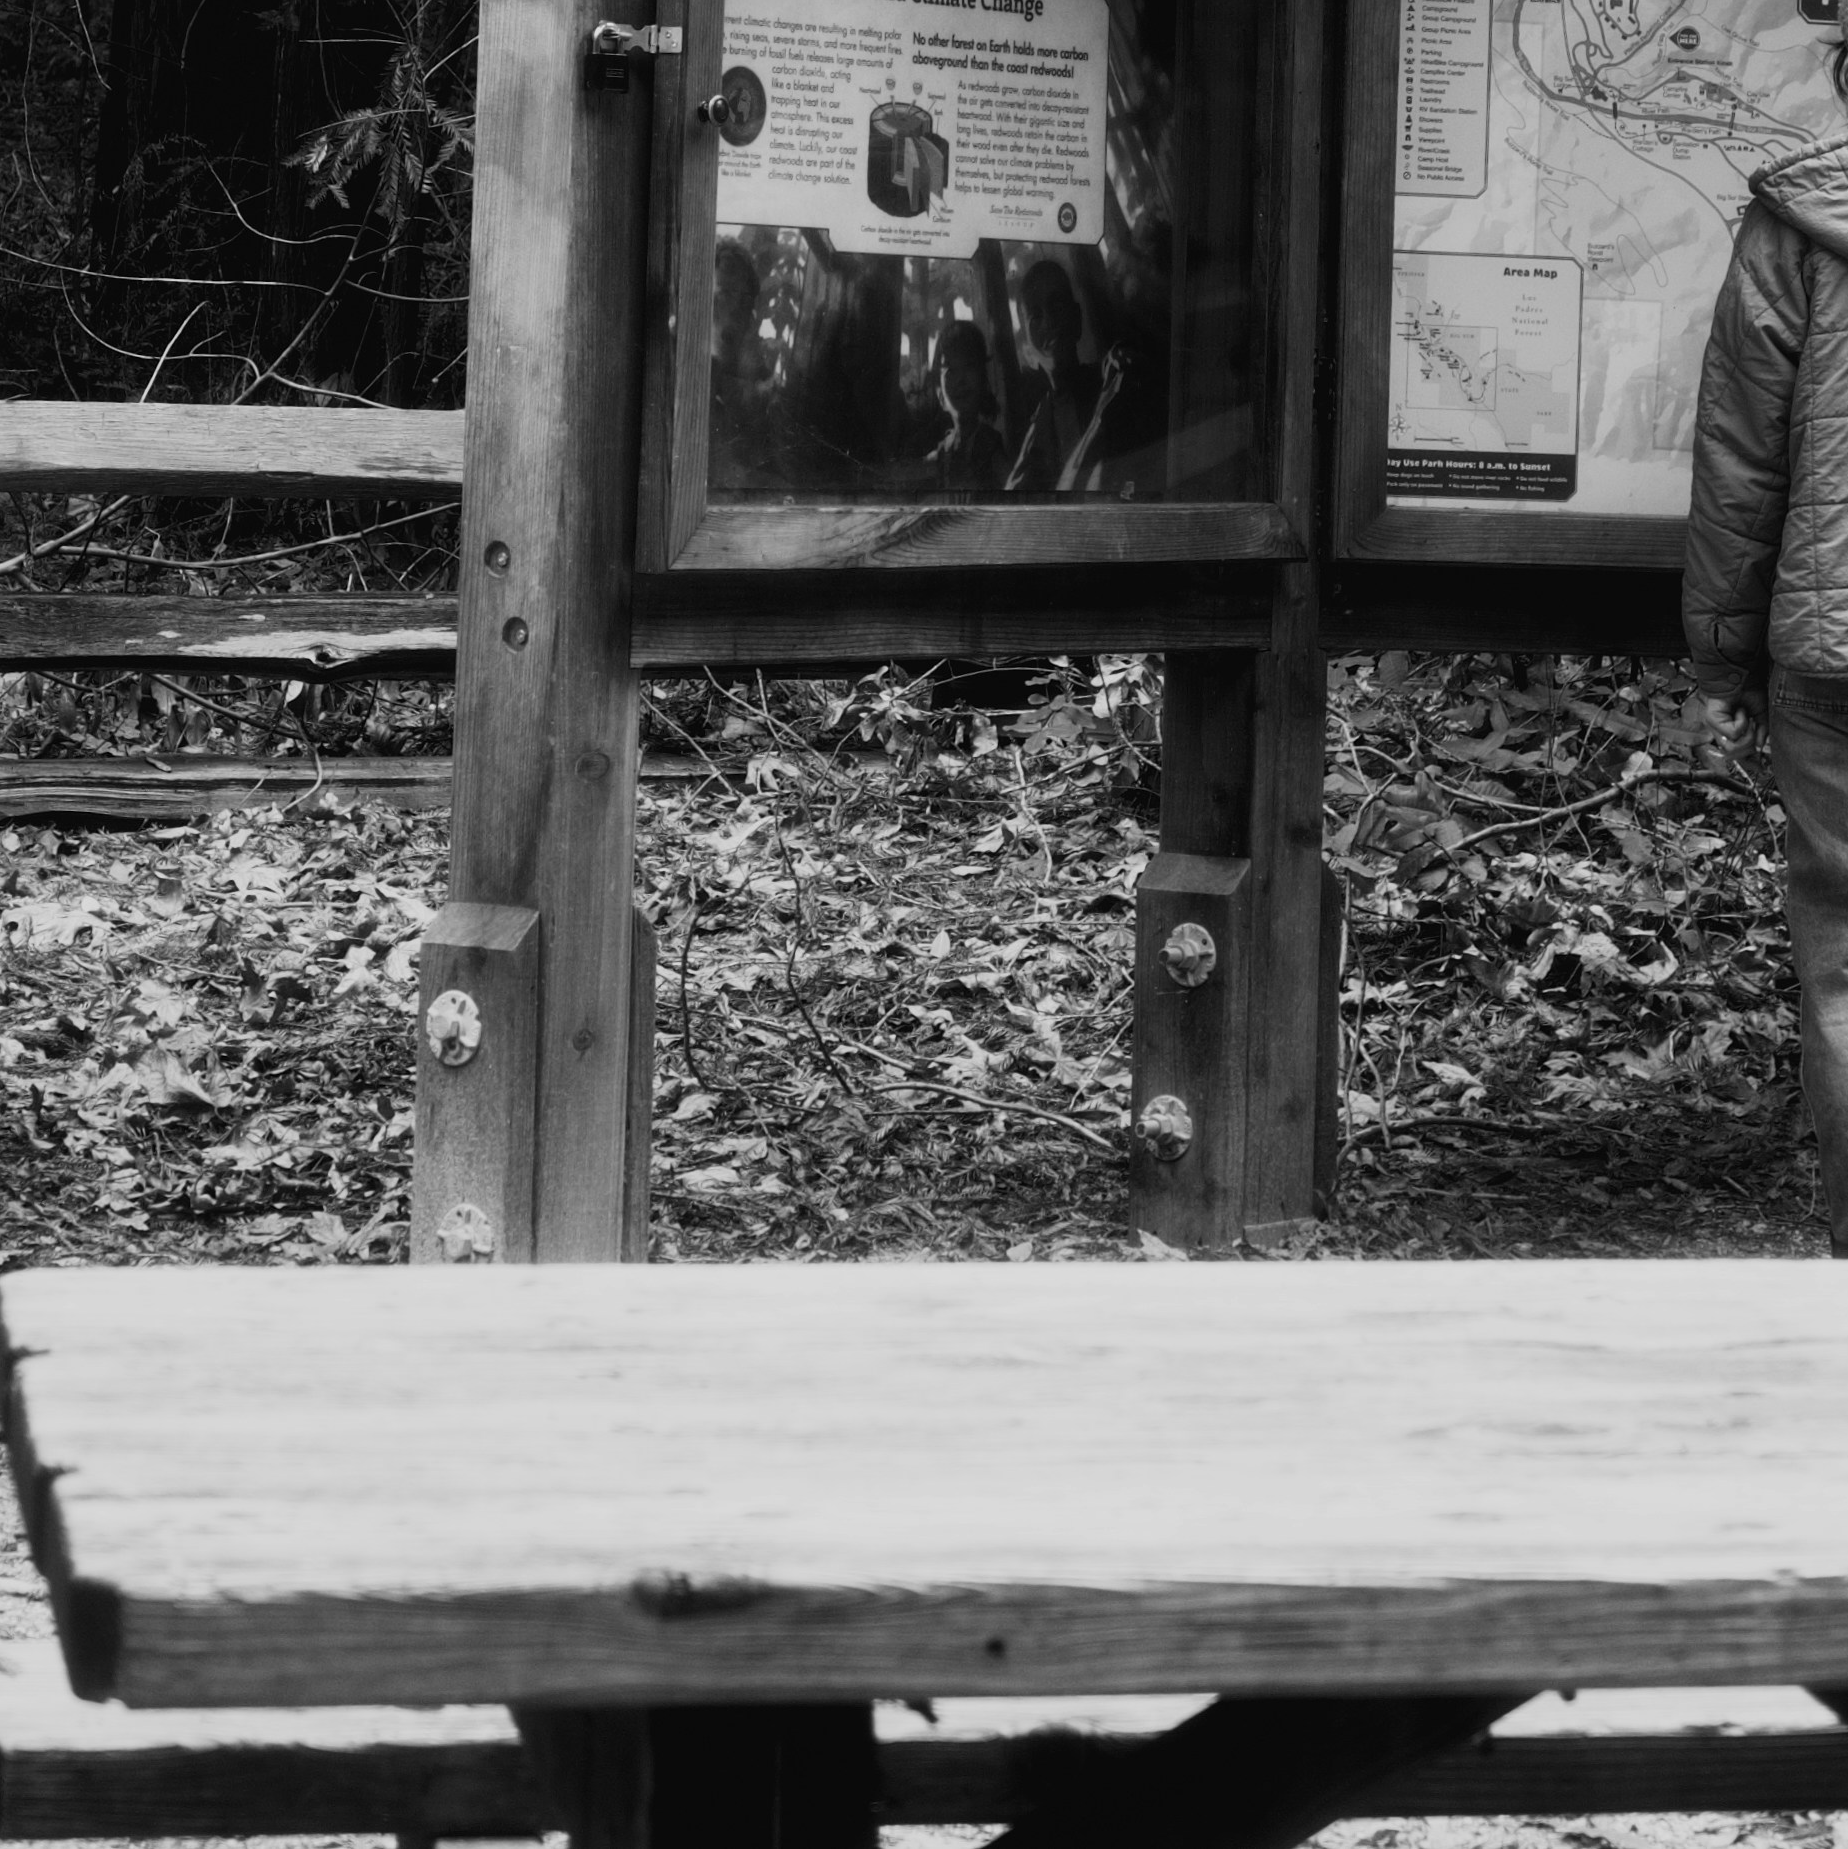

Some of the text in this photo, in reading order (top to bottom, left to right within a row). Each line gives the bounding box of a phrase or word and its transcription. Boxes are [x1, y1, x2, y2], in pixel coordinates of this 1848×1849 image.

[913, 32, 1089, 61] No other forest on Earth holds more carbon
[912, 53, 1075, 78] aboveground than the coast redwoods!
[1503, 267, 1558, 279] Area Map
[1403, 459, 1420, 467] Use
[1479, 461, 1484, 469] 8
[1520, 463, 1551, 471] Sunset
